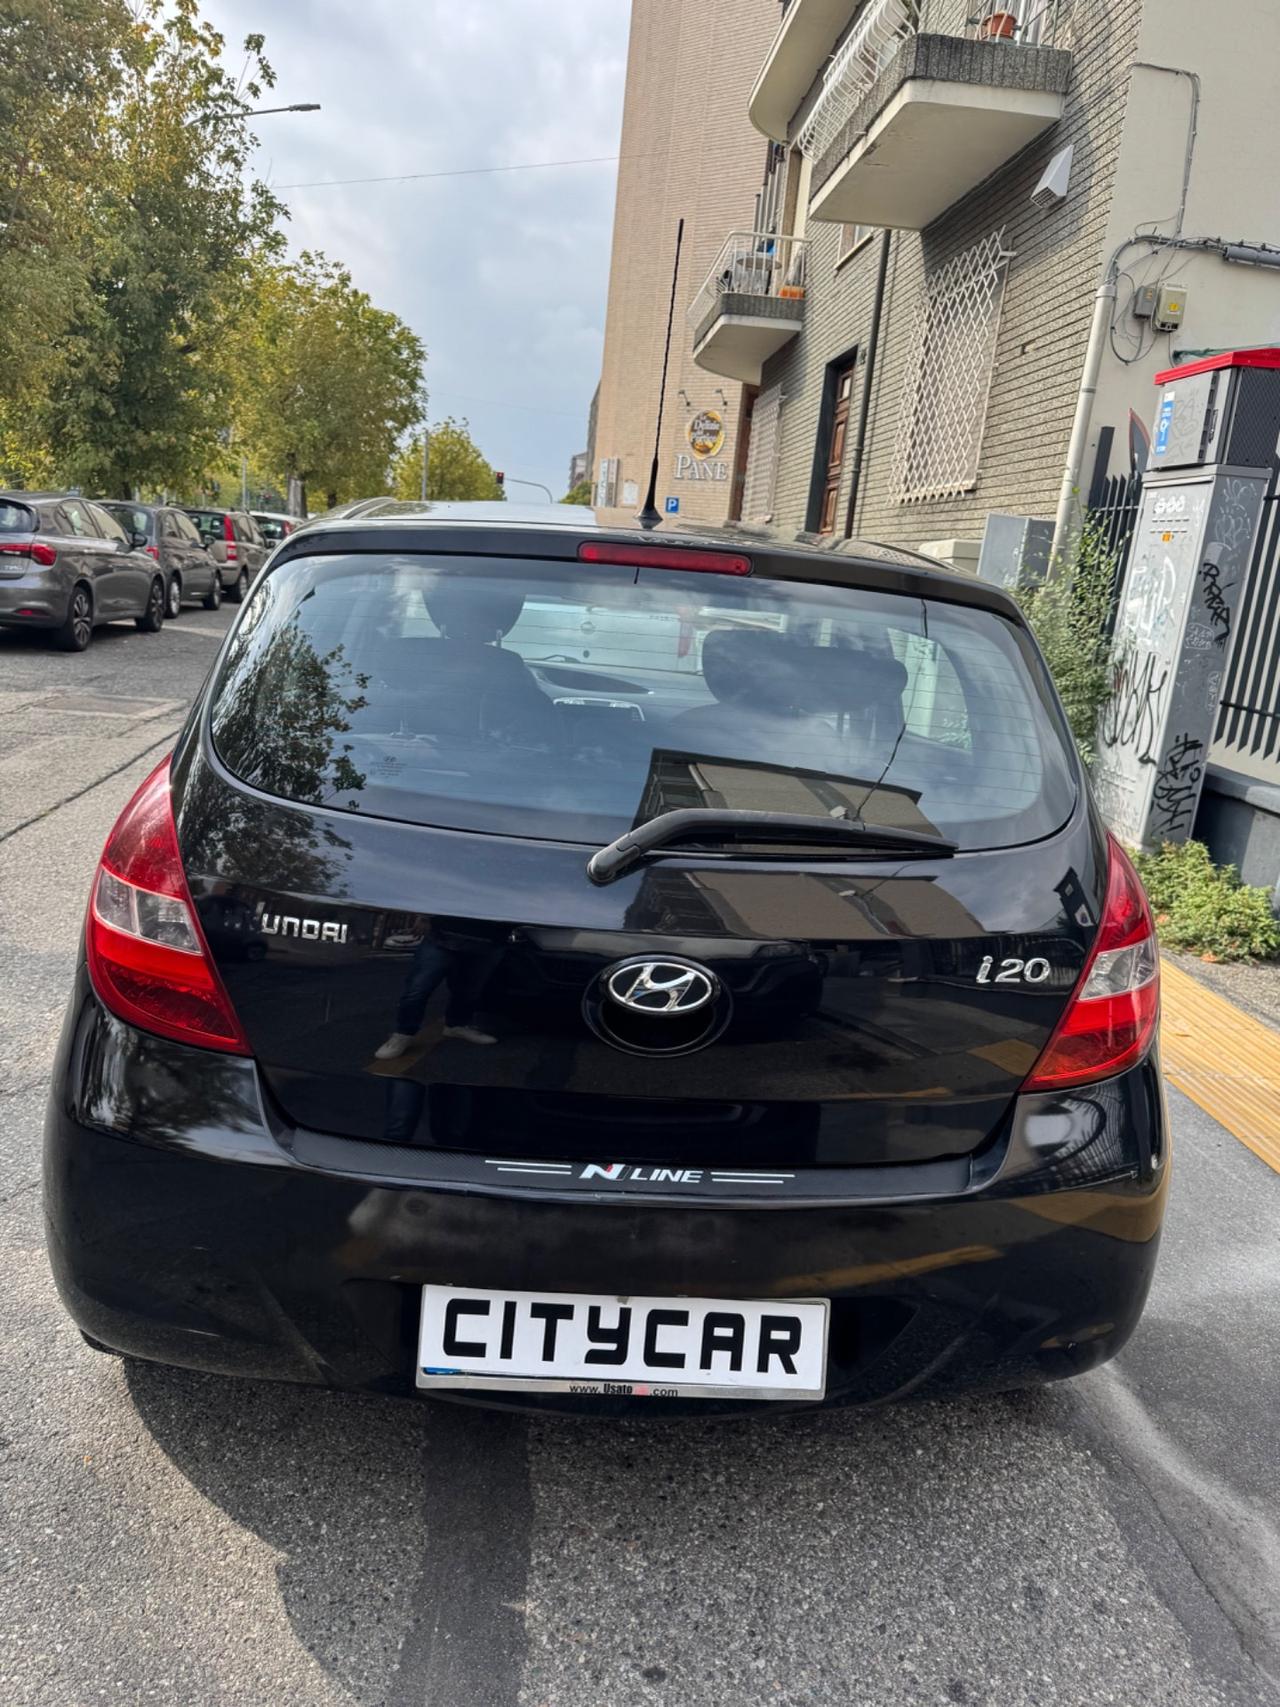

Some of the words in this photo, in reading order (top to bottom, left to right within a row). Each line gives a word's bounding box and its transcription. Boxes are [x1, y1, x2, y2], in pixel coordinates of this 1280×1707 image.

[675, 454, 728, 480] PANE
[976, 955, 1051, 984] i20
[579, 1164, 626, 1180] N
[630, 1168, 704, 1183] LINE
[443, 1298, 801, 1375] CITYCAR
